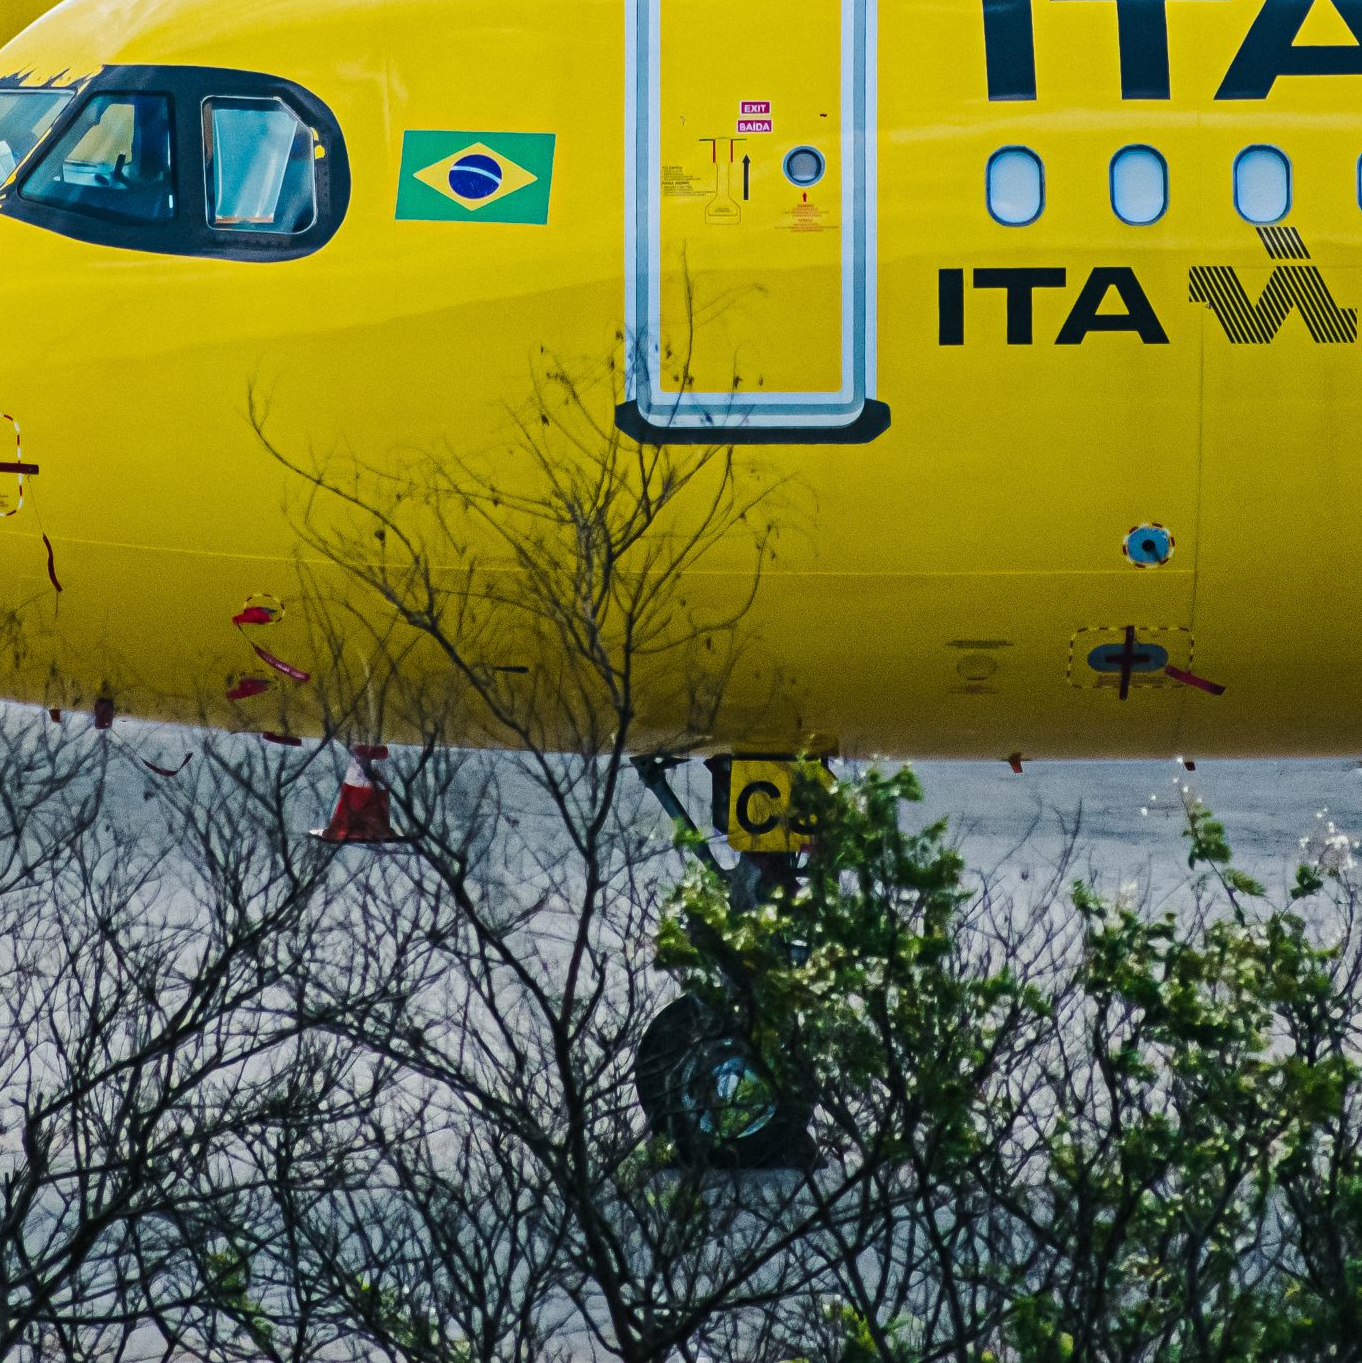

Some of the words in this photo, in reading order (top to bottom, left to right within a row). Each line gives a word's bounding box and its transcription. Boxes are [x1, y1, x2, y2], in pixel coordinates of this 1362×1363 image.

[744, 104, 767, 113] EXIT
[739, 120, 770, 131] SAÍDA
[939, 267, 1169, 345] ITA
